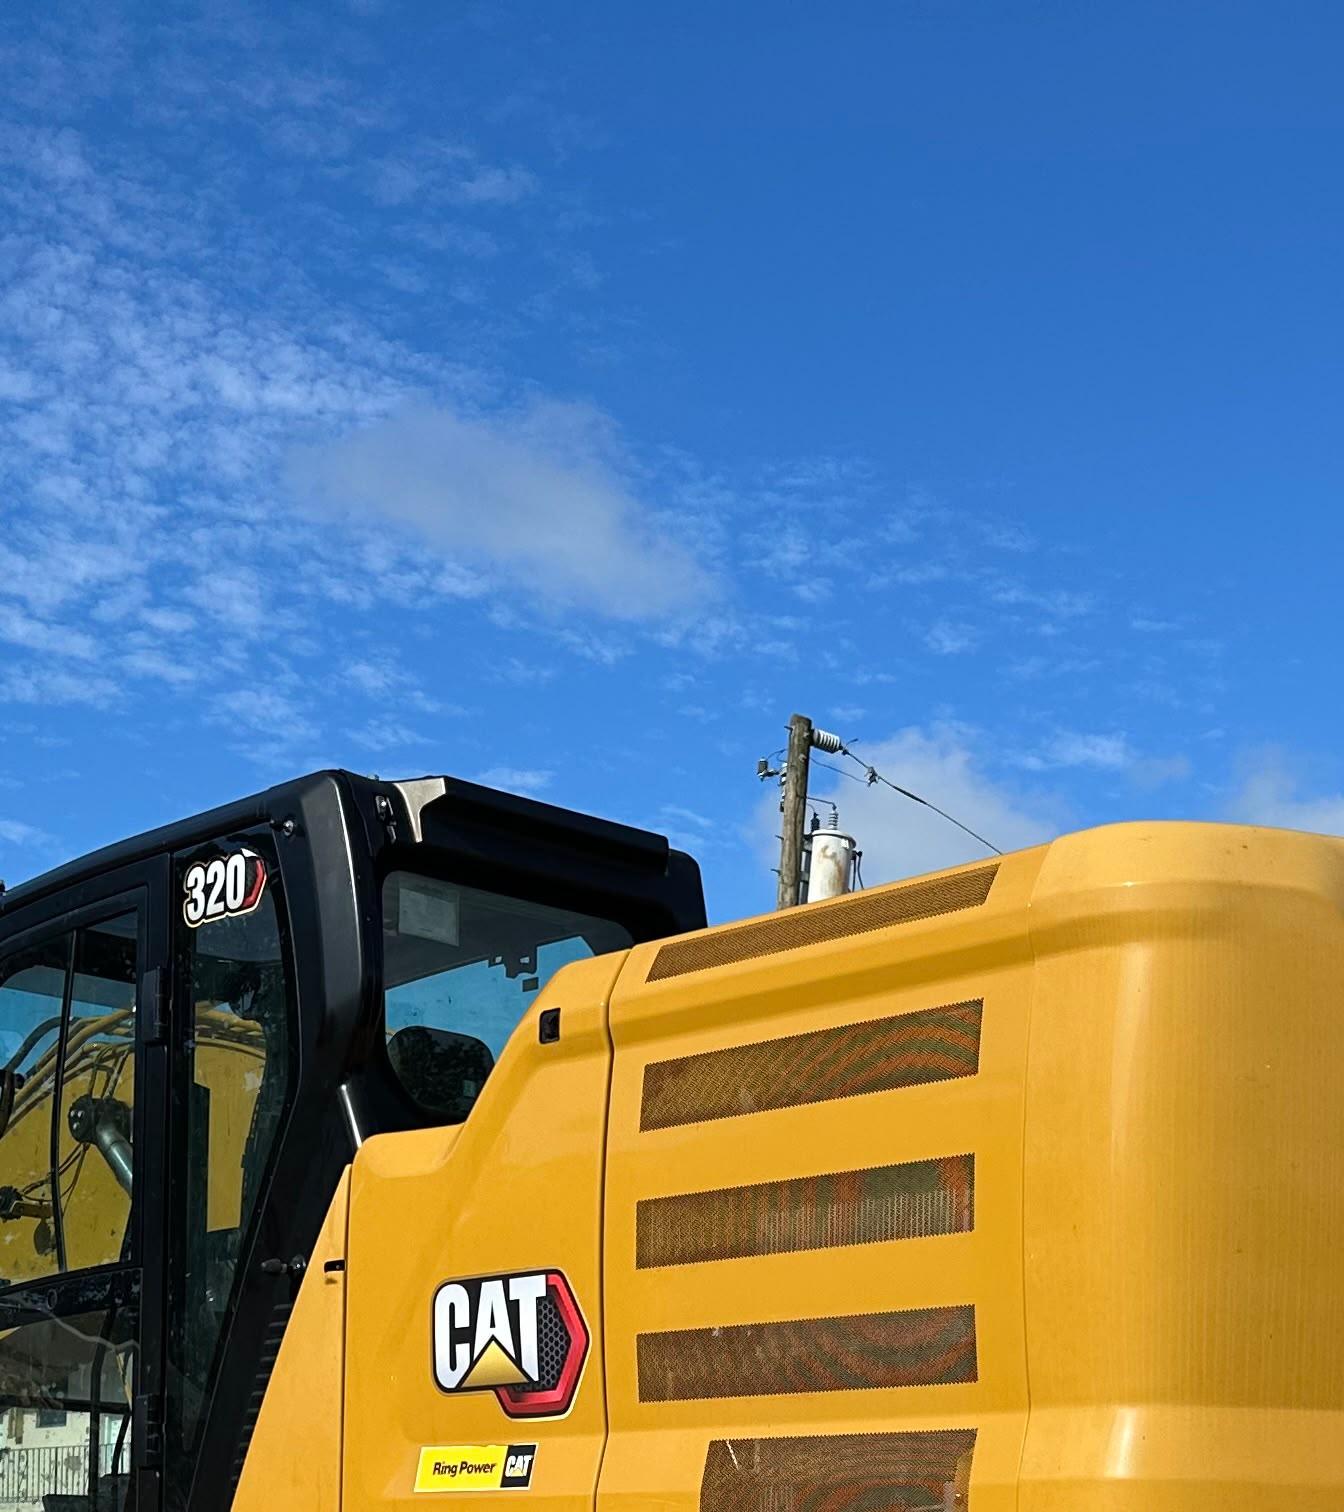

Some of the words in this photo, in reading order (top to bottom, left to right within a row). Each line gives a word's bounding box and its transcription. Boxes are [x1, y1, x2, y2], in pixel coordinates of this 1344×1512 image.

[186, 853, 246, 921] 320
[434, 1273, 547, 1389] CAT
[433, 1461, 458, 1478] Ring
[459, 1460, 497, 1475] Power
[505, 1454, 534, 1478] CAT
